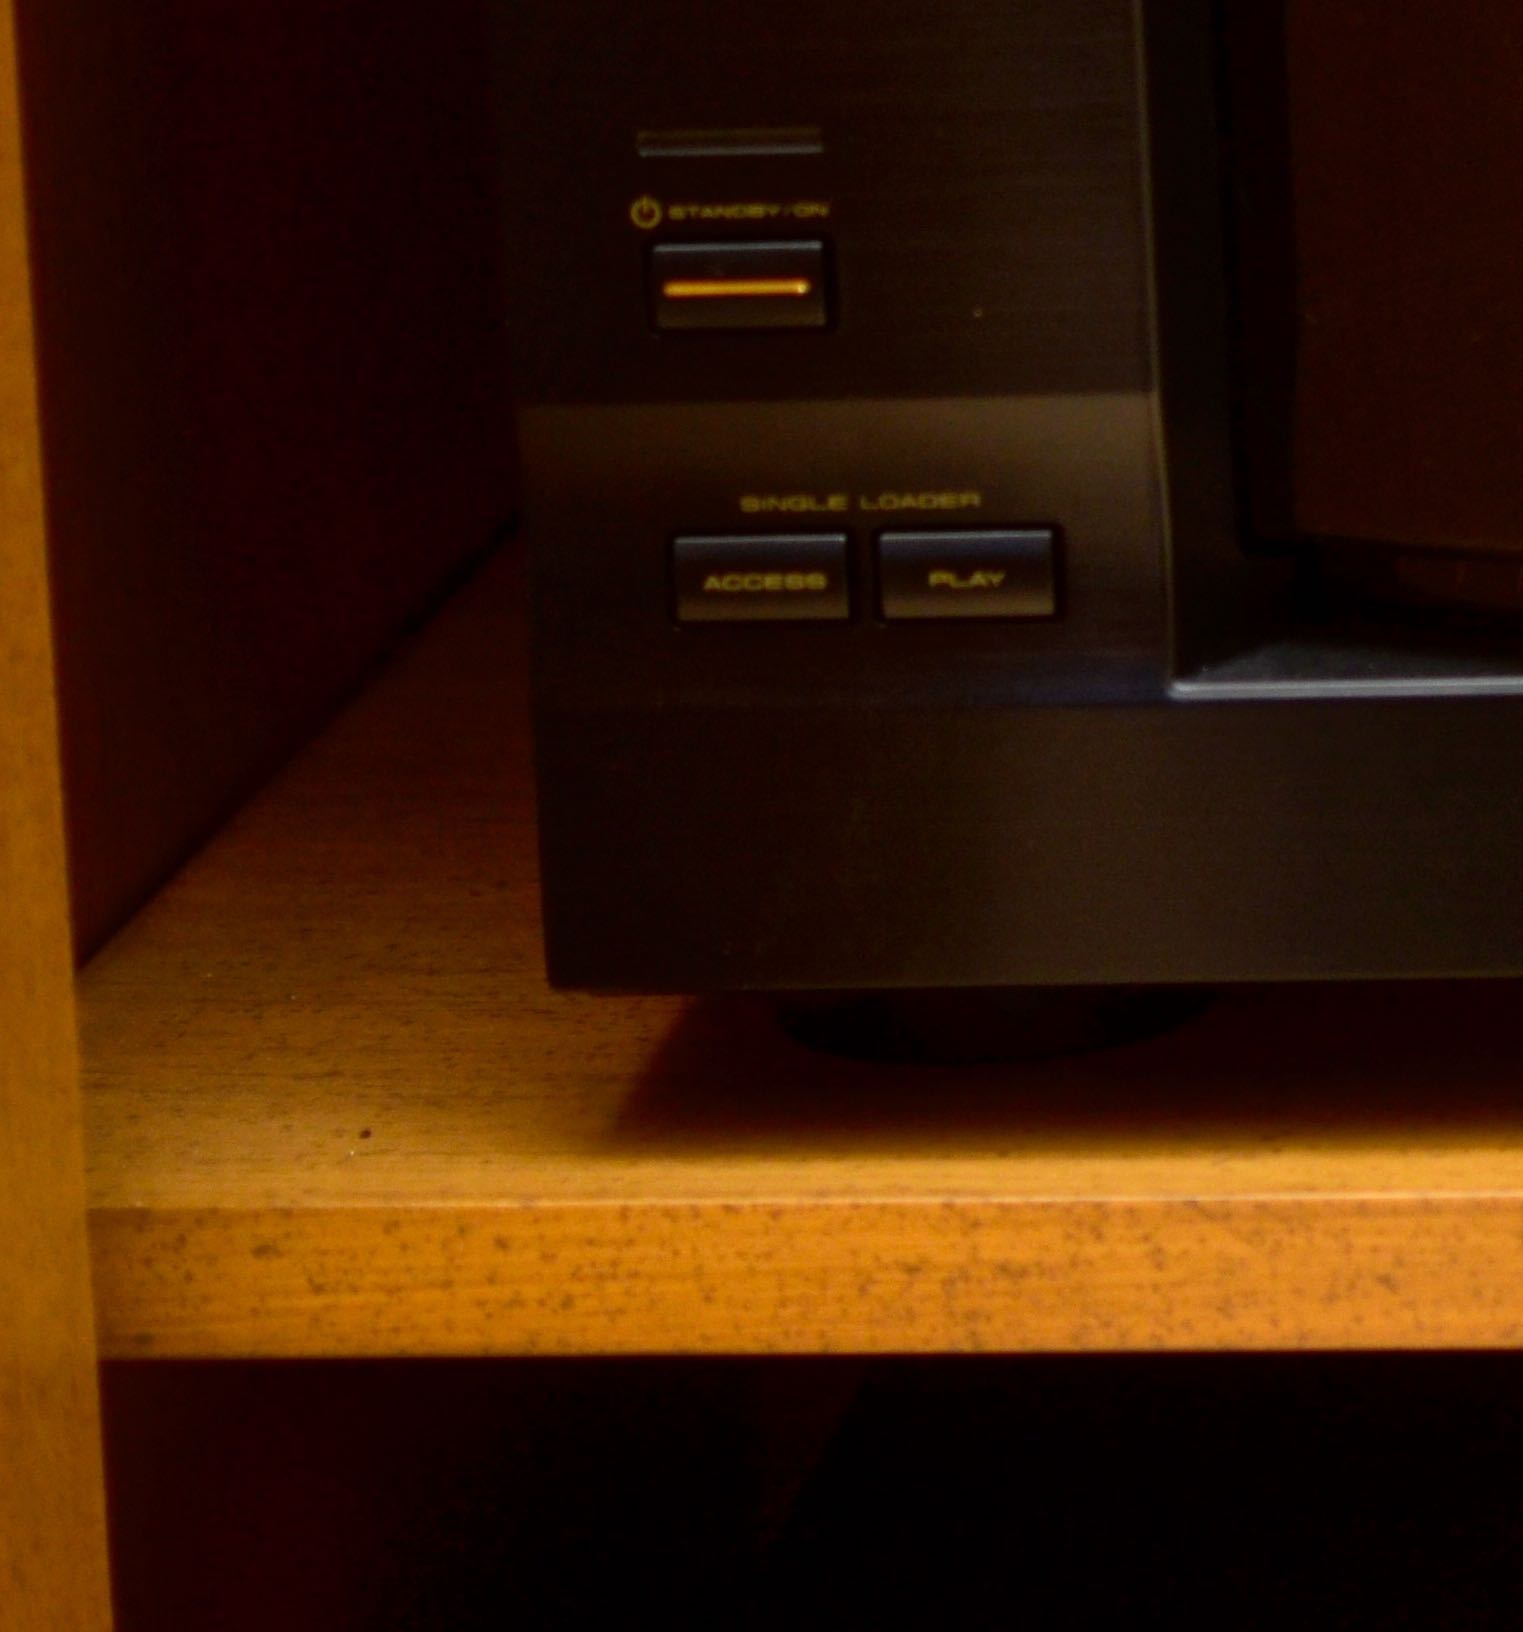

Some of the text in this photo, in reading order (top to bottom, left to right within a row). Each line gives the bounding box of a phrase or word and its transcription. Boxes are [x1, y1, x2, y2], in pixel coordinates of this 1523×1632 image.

[667, 200, 830, 220] STANDBY/ON
[739, 492, 982, 513] SINGLE LOADER
[703, 572, 828, 592] ACCESS
[928, 569, 1005, 590] PLAY
